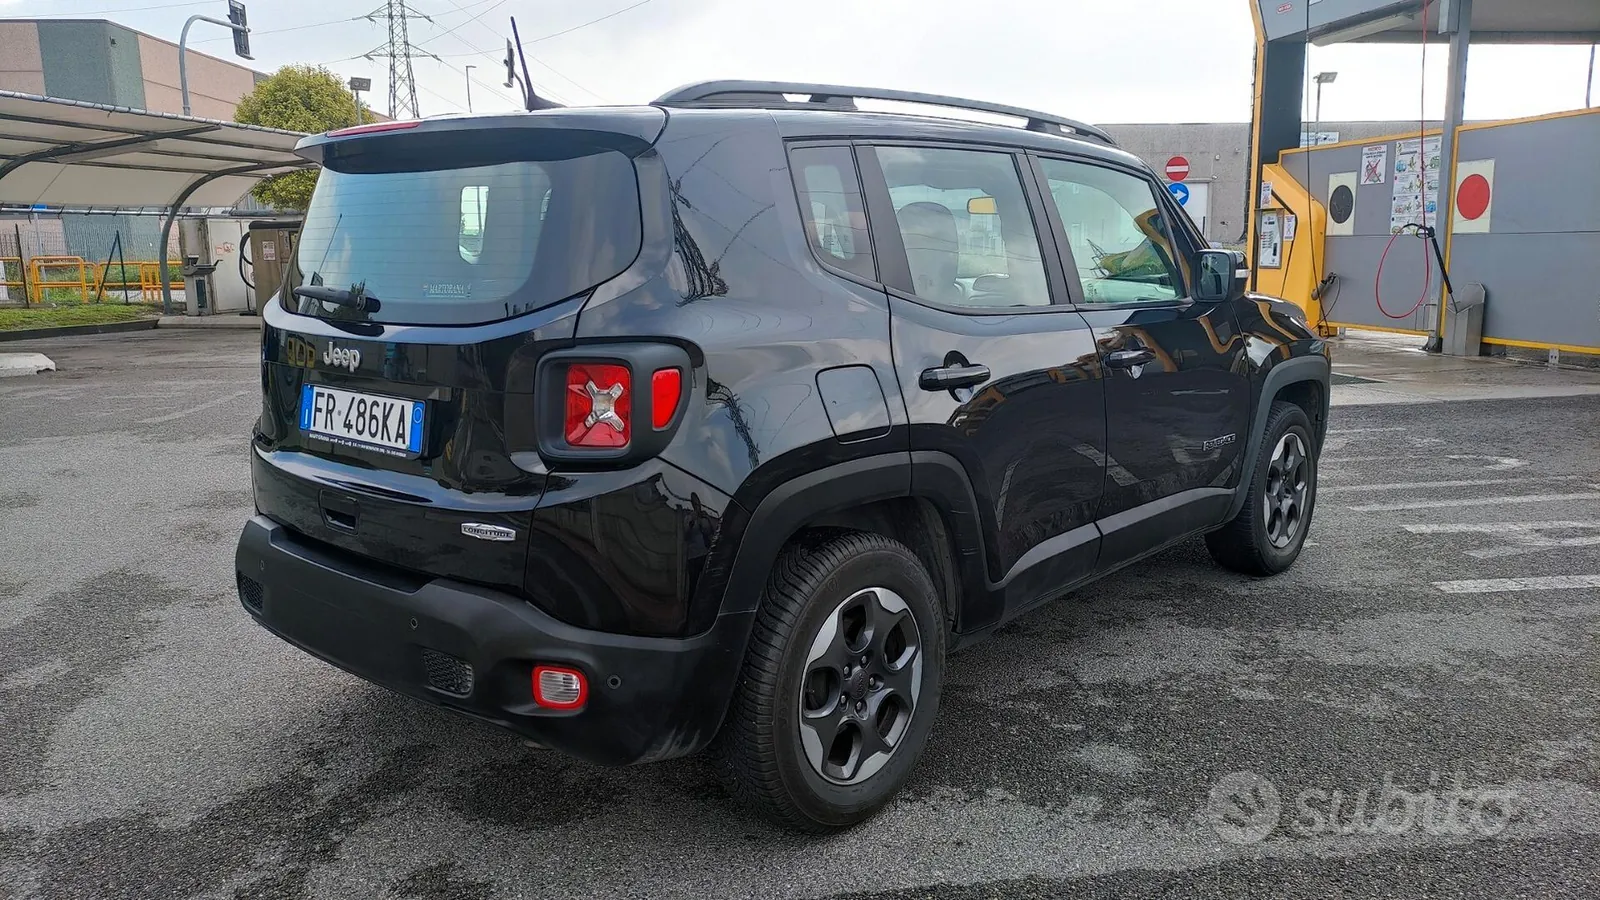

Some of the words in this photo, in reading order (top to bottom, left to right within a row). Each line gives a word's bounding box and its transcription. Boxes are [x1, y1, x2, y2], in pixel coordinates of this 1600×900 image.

[323, 341, 360, 372] Jeep
[313, 392, 336, 430] FR
[343, 396, 406, 444] 486KA
[463, 526, 513, 538] LONGITUDE
